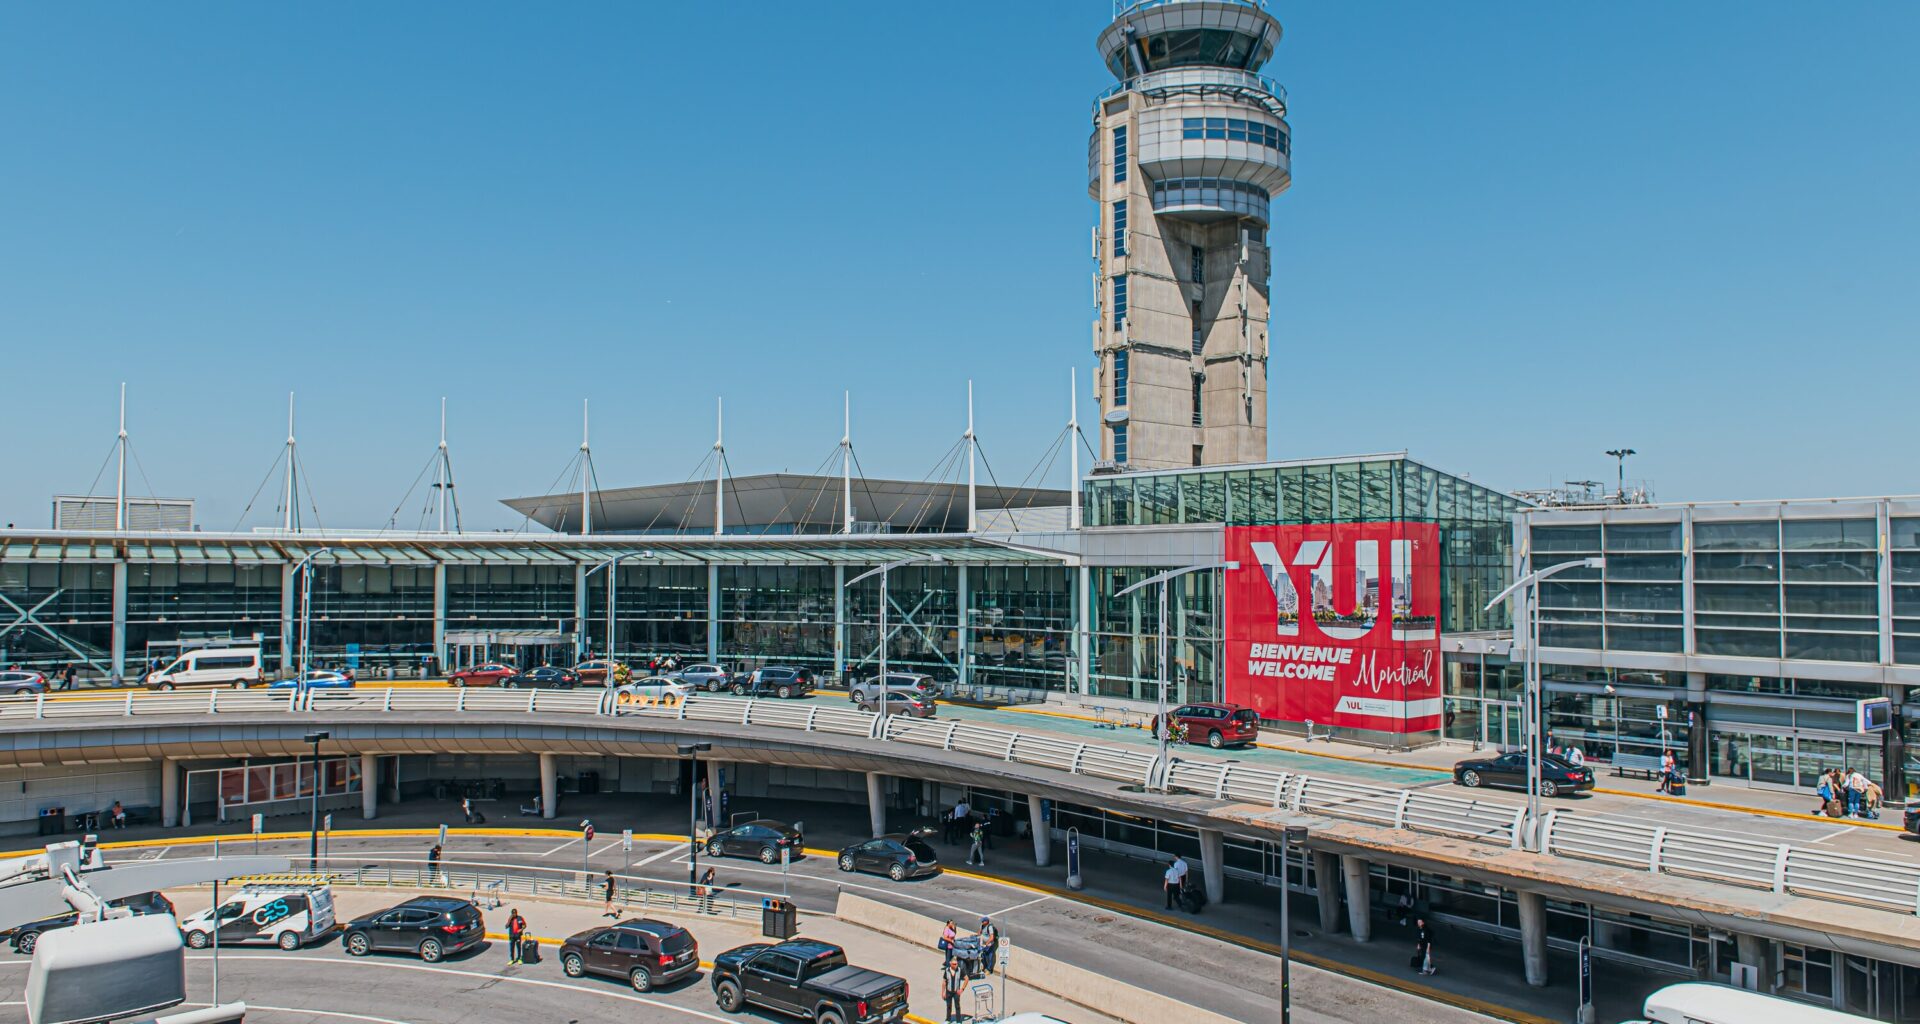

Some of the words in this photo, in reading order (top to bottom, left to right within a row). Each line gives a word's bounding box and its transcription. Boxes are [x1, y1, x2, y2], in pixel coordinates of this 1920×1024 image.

[1250, 539, 1436, 641] YUL
[1249, 643, 1354, 665] BIENVENUE
[1353, 648, 1433, 693] Montréal
[1248, 660, 1337, 682] WELCOME
